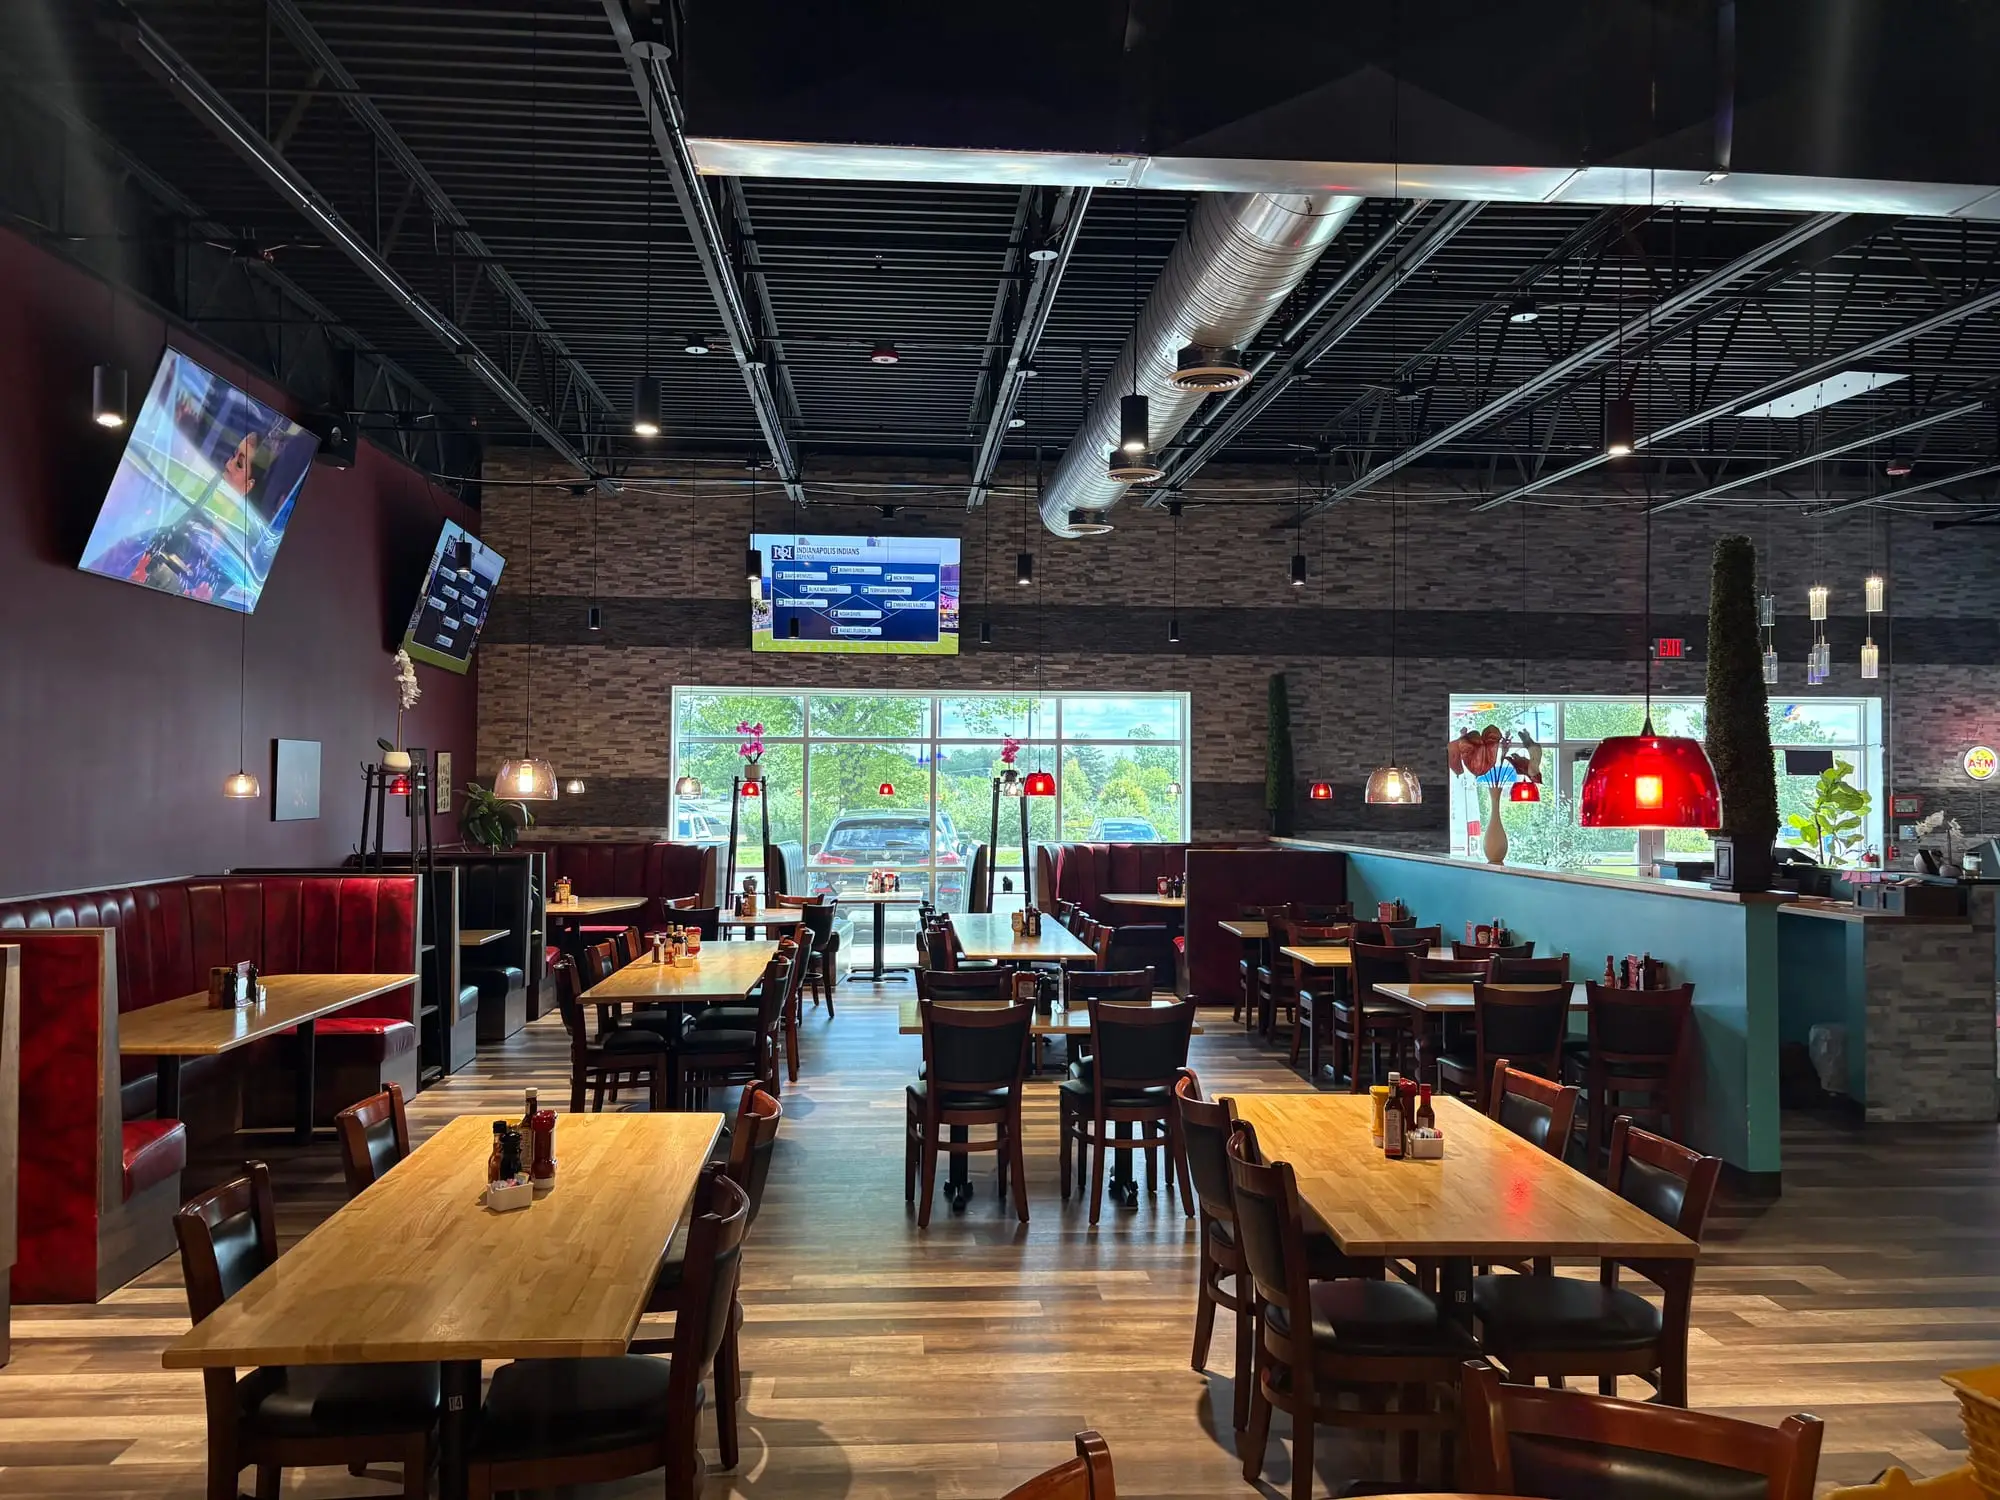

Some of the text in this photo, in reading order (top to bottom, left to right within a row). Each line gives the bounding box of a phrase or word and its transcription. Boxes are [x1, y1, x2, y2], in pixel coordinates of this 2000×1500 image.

[796, 546, 836, 555] INDIANAPOLIS
[836, 547, 860, 555] INDIANS
[1659, 639, 1681, 657] EXIT
